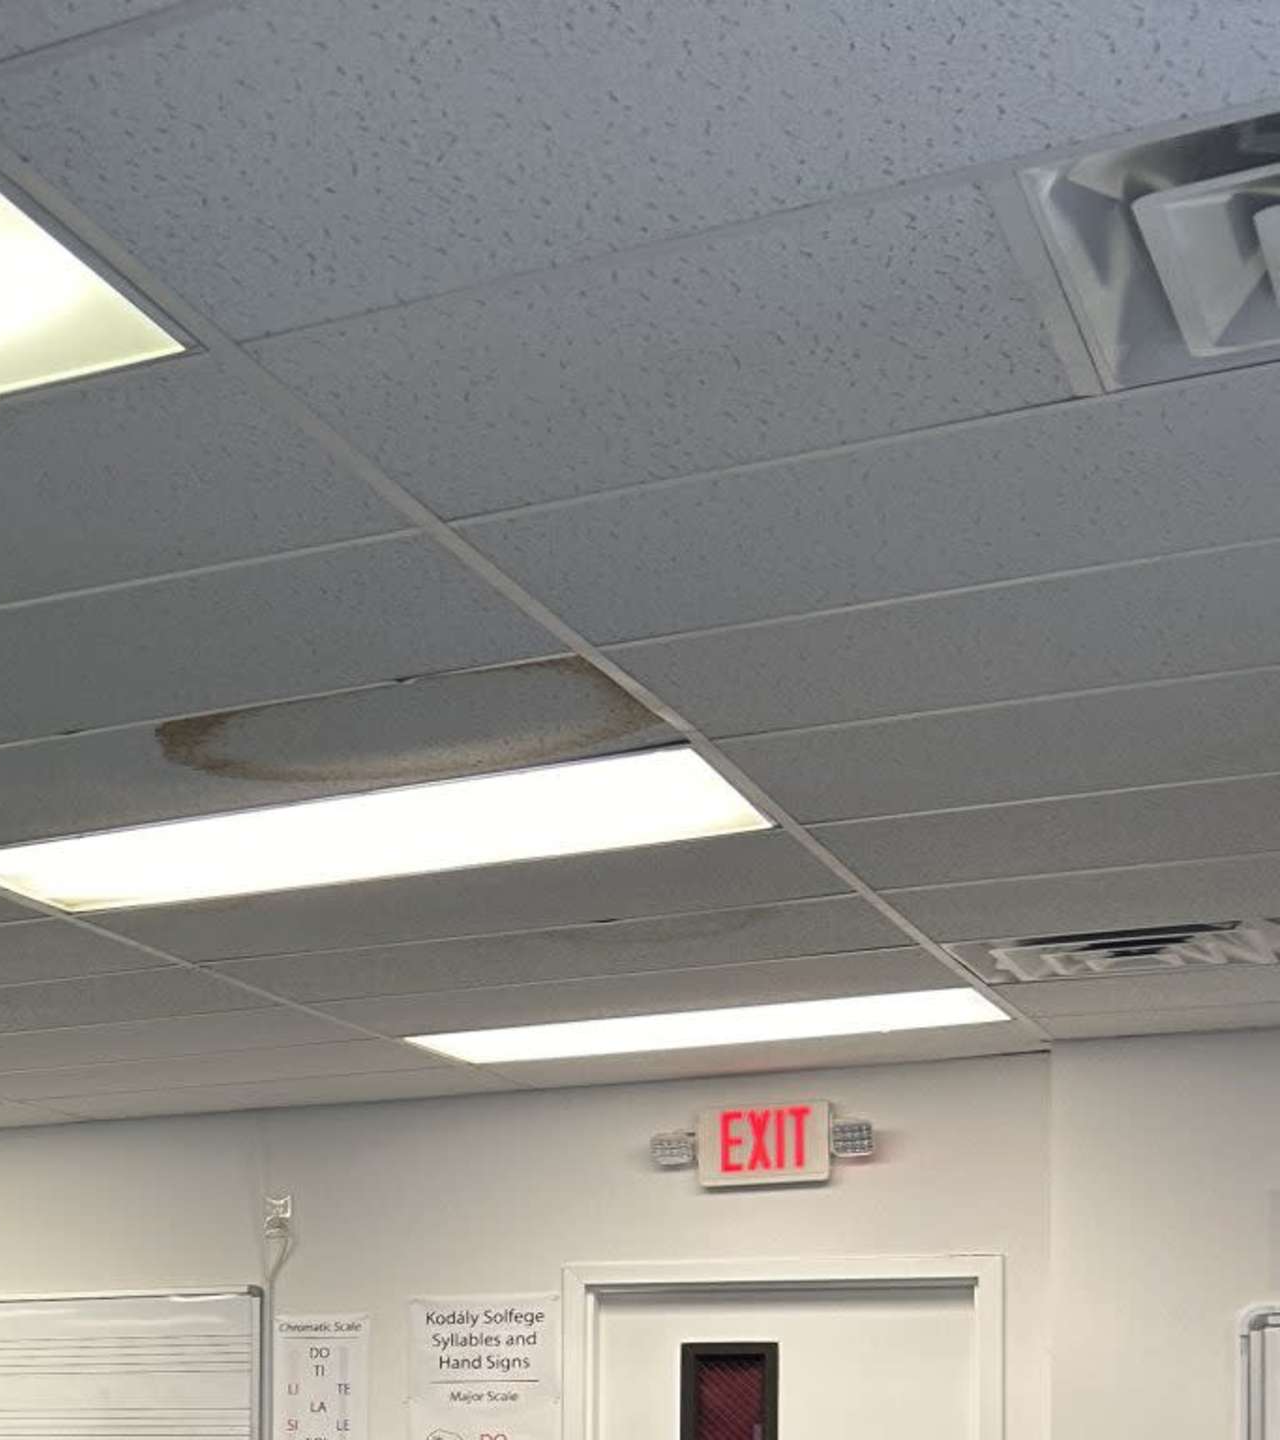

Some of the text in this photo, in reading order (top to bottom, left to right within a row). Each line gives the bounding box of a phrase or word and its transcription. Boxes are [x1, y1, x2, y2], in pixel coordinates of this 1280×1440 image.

[719, 1106, 811, 1173] EXIT
[483, 1308, 545, 1327] Solfege
[333, 1320, 362, 1332] Scale
[431, 1332, 537, 1351] Syllables and
[309, 1347, 330, 1359] DO
[314, 1364, 325, 1377] TI
[439, 1354, 531, 1373] Hand Signs
[336, 1383, 351, 1396] TE
[449, 1390, 519, 1404] Major Scale
[309, 1401, 327, 1413] LA
[286, 1418, 299, 1432] SI
[336, 1418, 351, 1432] LE
